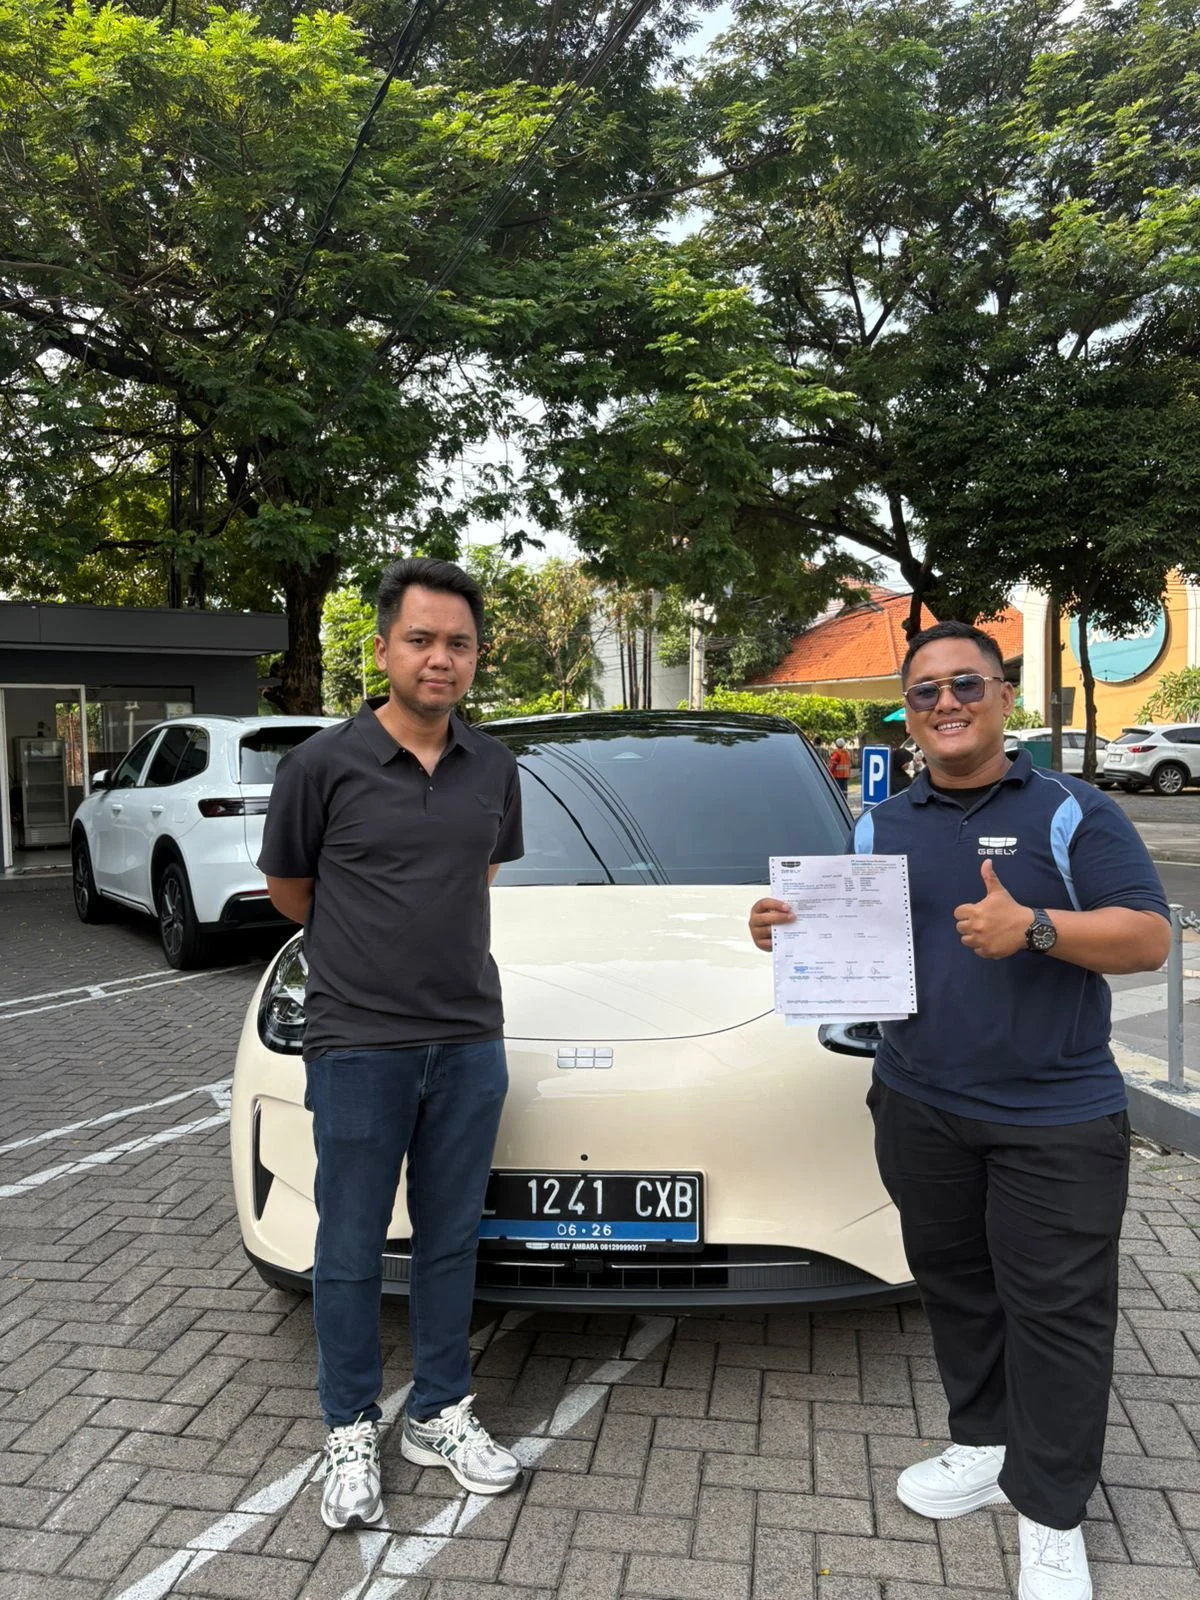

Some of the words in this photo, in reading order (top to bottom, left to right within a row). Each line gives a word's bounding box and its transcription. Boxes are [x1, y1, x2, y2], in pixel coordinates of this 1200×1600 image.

[869, 754, 884, 797] P
[977, 848, 1018, 856] GEELY
[527, 1178, 604, 1215] 1241
[635, 1180, 693, 1218] CXB
[572, 1243, 599, 1251] AMBARA
